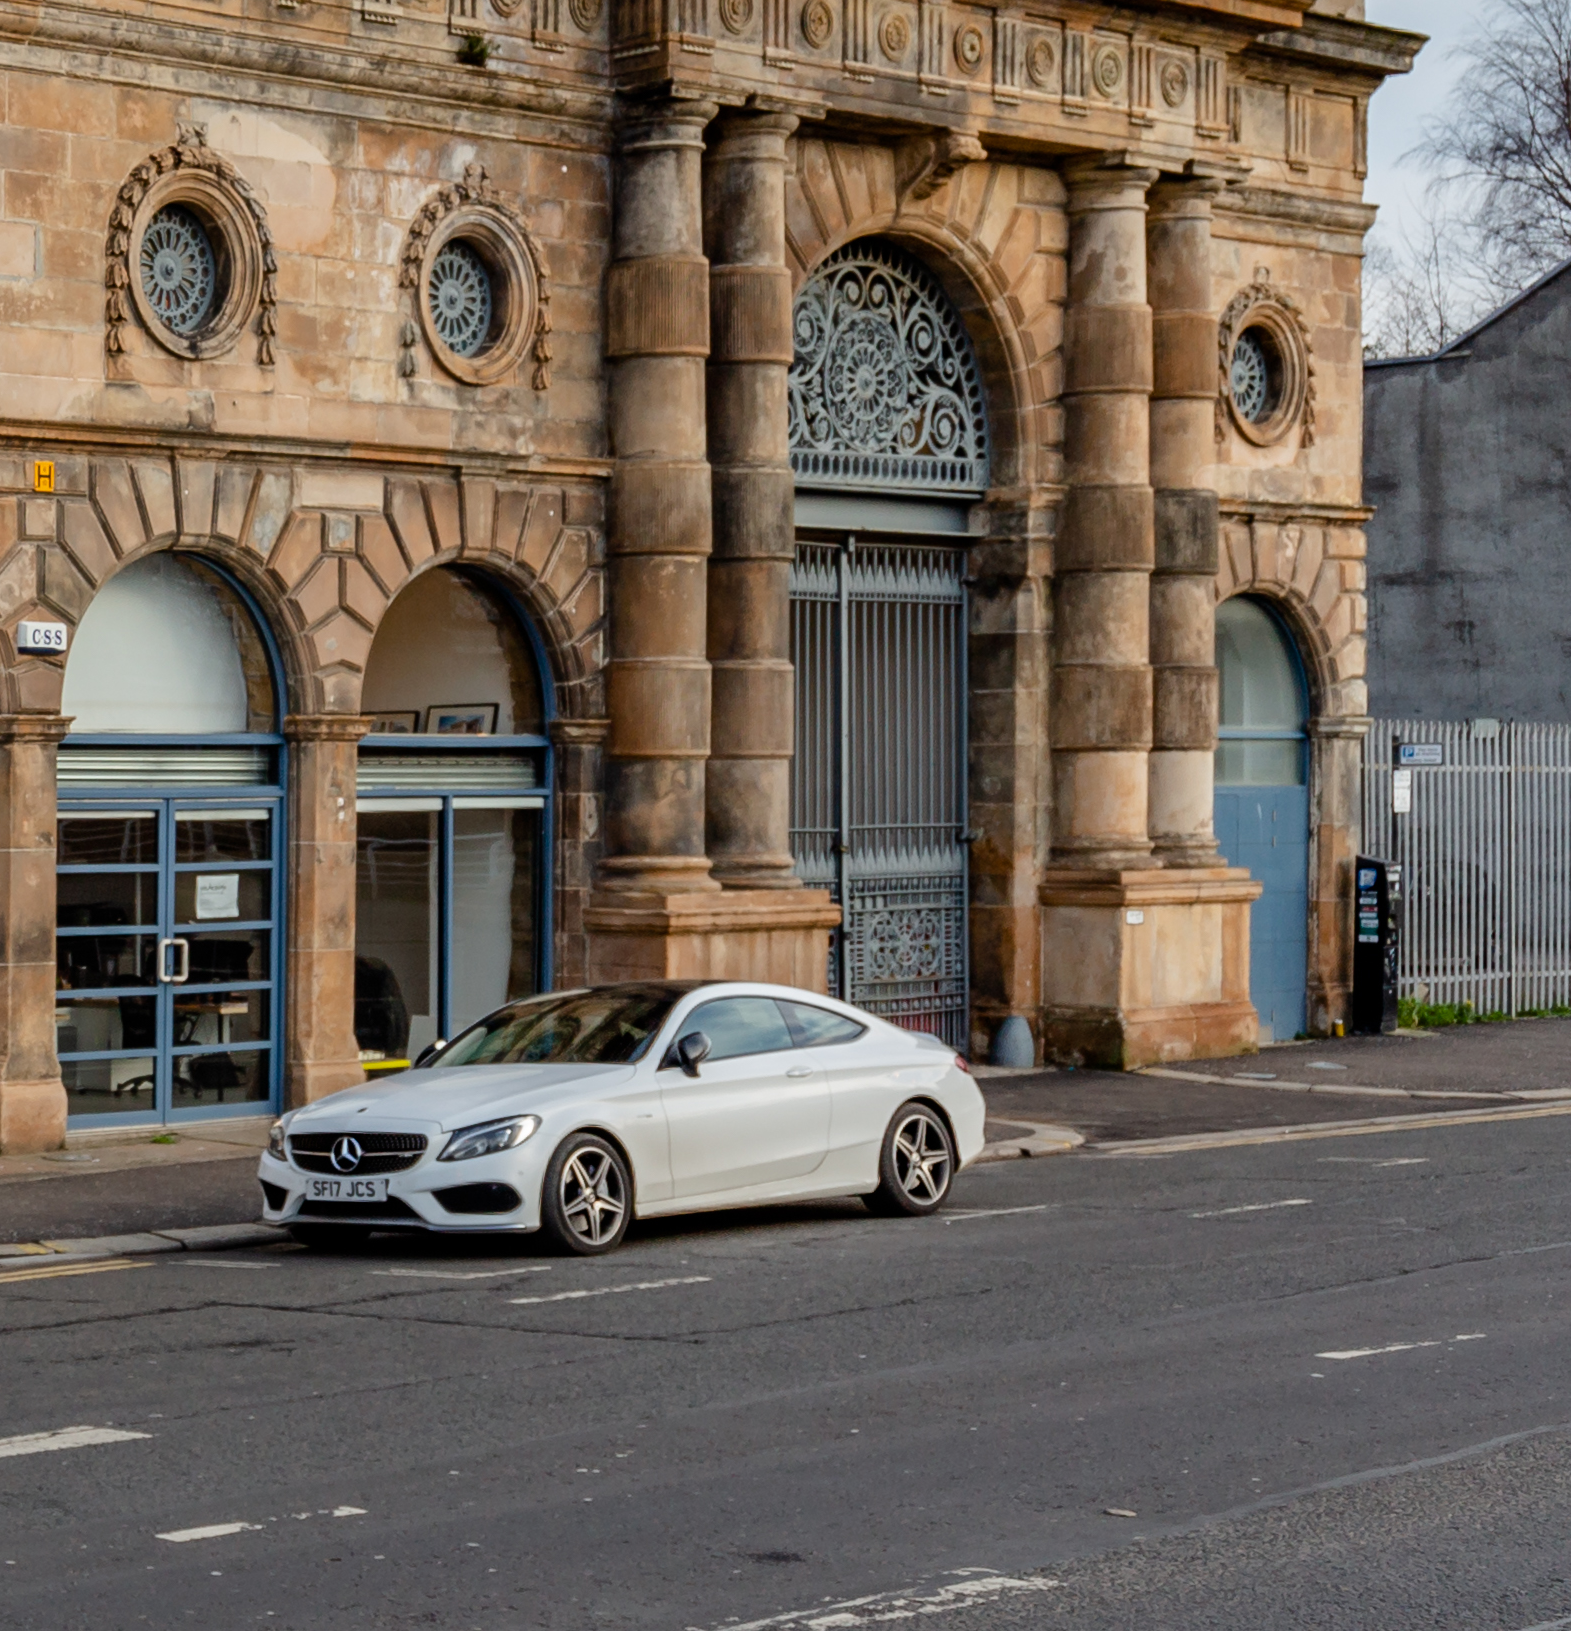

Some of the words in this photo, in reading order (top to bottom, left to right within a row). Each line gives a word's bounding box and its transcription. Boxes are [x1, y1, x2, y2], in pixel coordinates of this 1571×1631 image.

[38, 465, 52, 488] H
[312, 1180, 341, 1197] SF17
[346, 1181, 376, 1198] JCS
